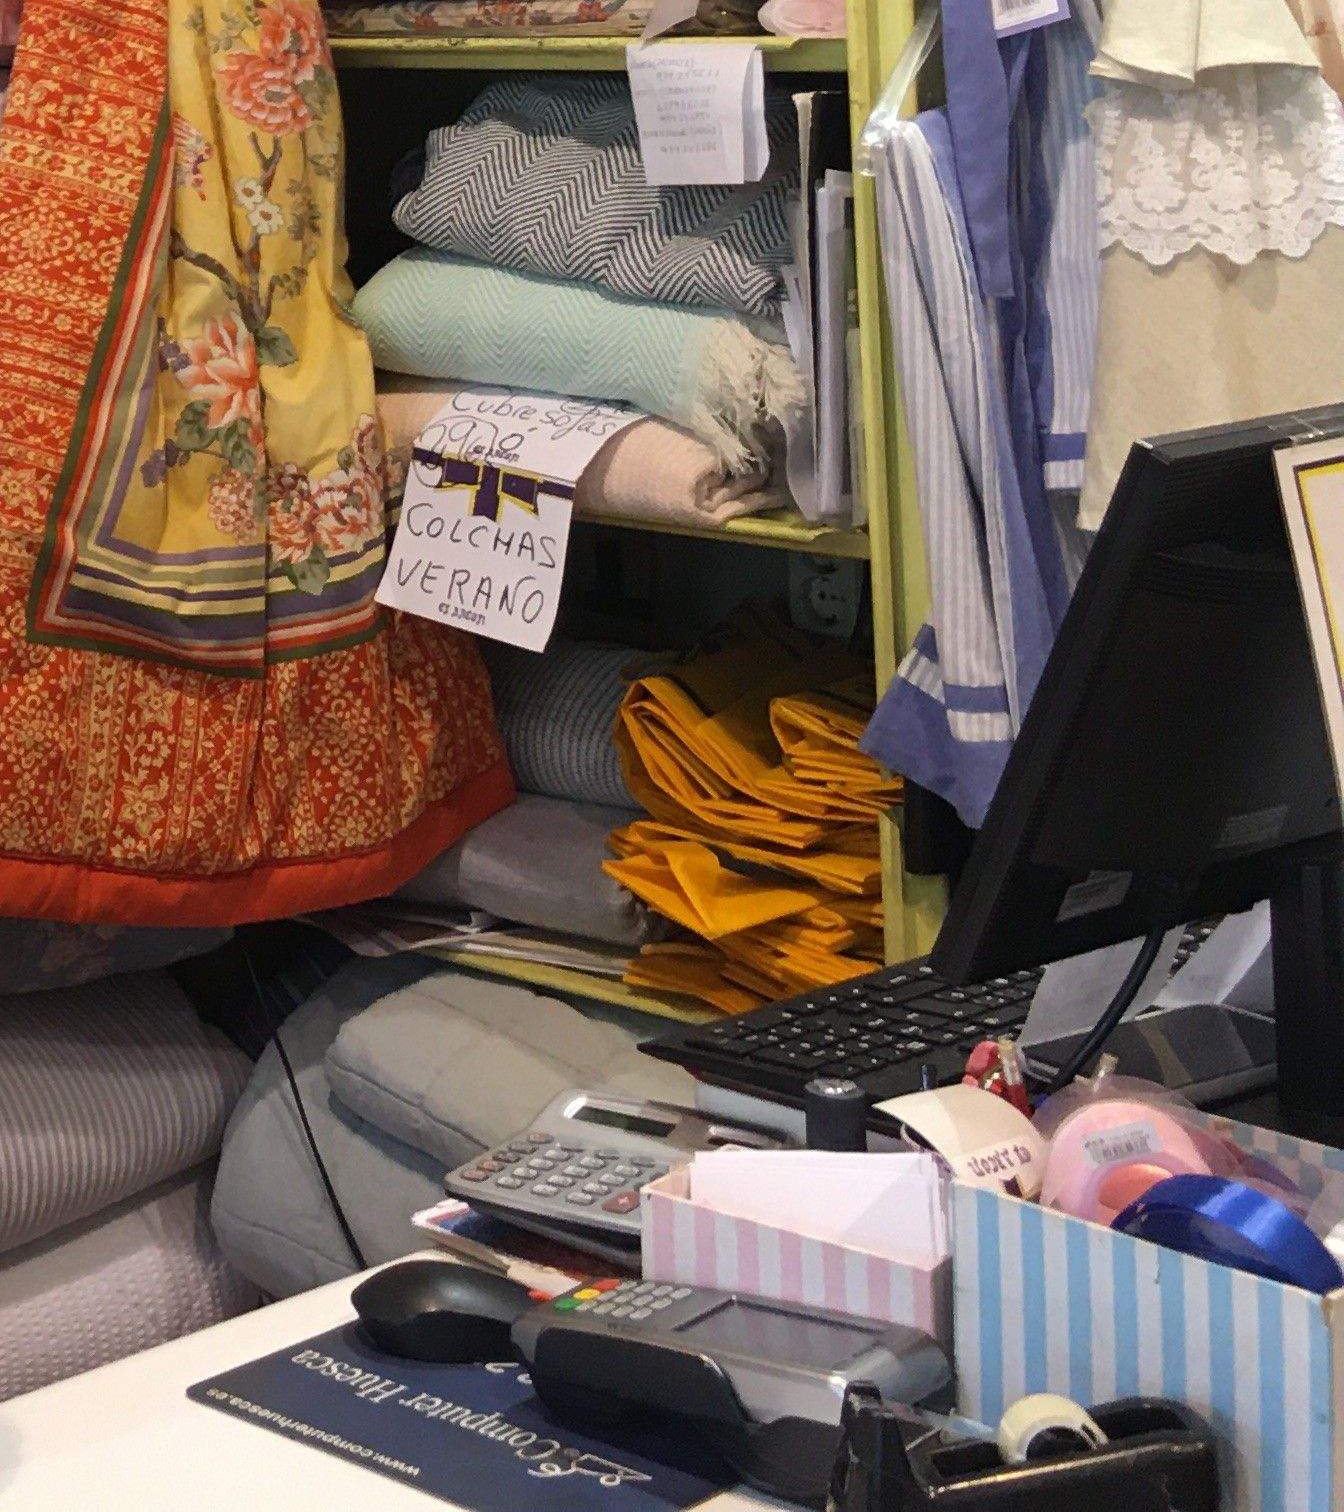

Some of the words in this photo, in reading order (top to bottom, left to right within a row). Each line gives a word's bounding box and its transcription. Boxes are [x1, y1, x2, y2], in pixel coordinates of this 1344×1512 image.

[407, 502, 557, 568] COLCHAS
[397, 557, 545, 624] VERANO
[292, 1349, 408, 1403] Huesca
[206, 1387, 421, 1476] www.computerhuesca.es
[399, 1393, 561, 1460] Computer
